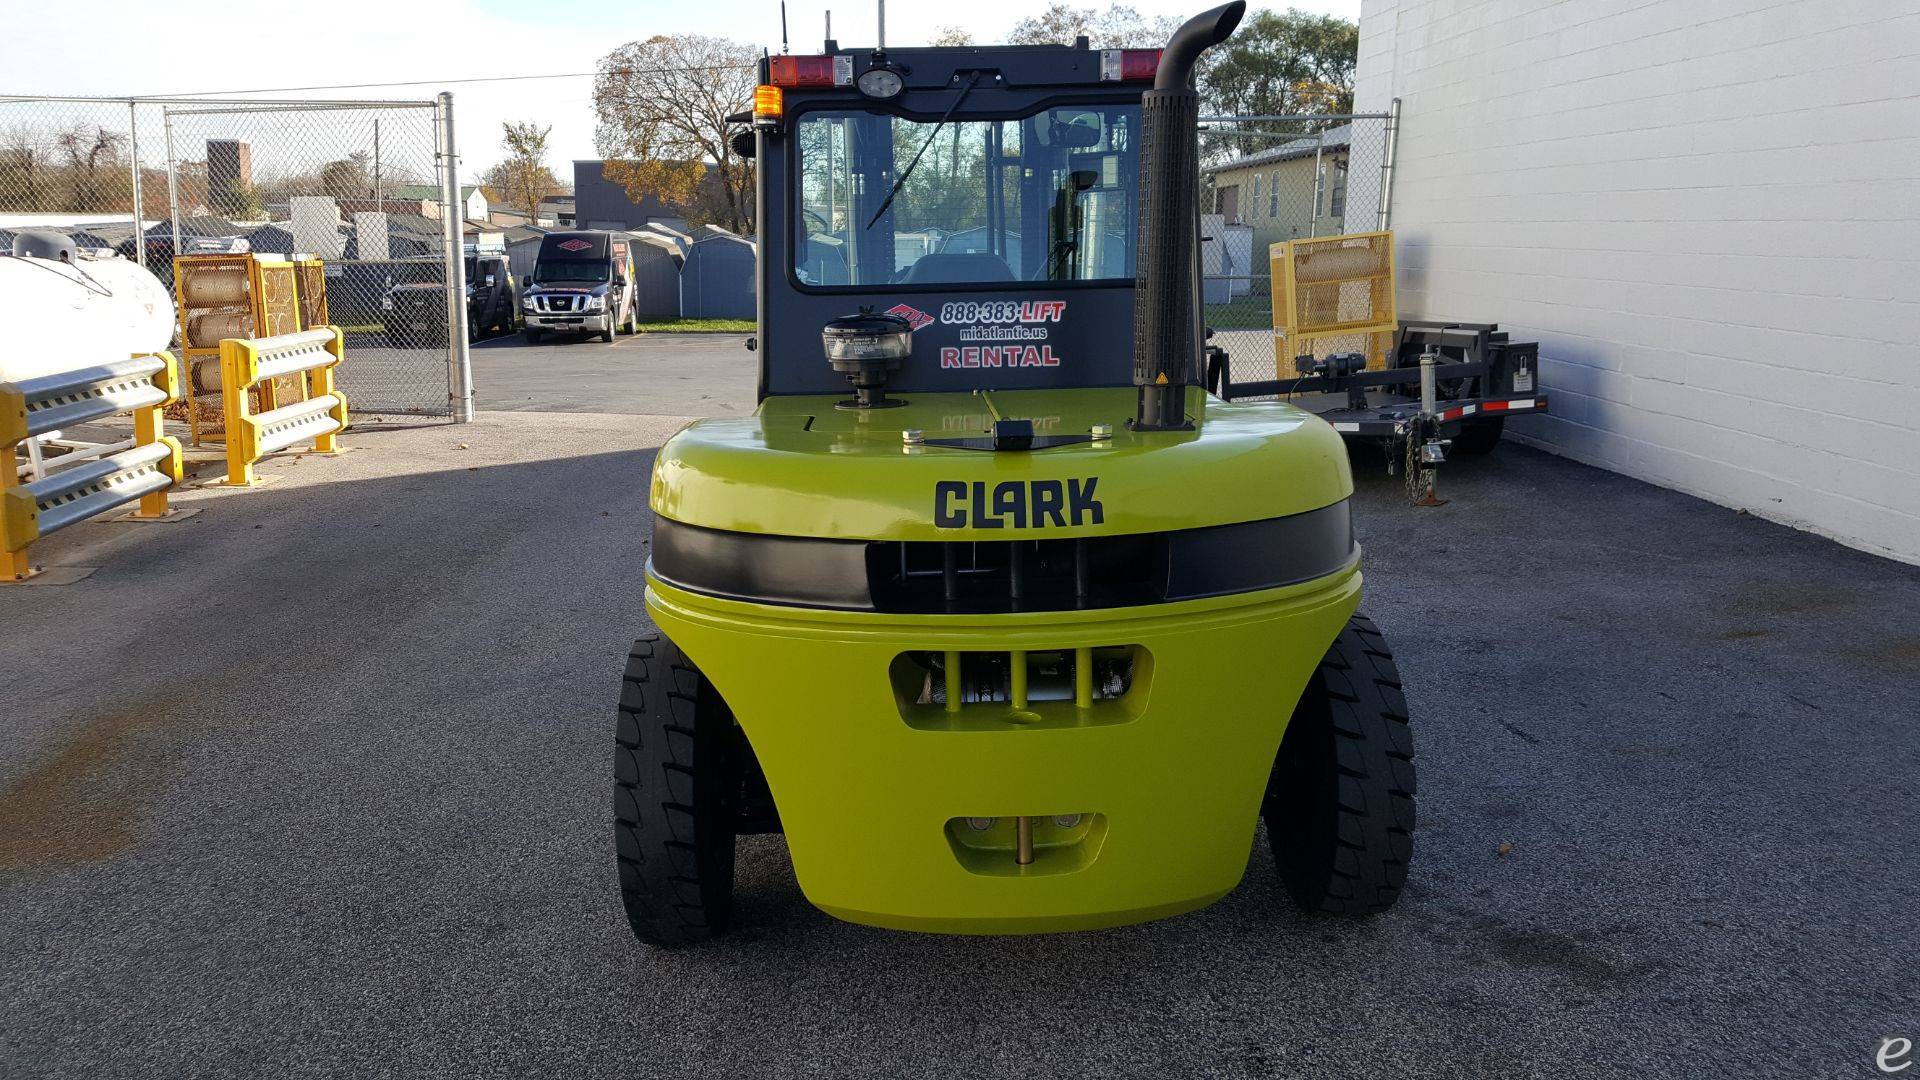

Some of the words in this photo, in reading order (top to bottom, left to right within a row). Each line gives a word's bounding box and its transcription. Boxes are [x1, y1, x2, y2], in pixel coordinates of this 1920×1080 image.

[960, 325, 1048, 341] midatlantic.us
[941, 345, 1061, 368] RENTAL
[934, 477, 1105, 529] CLARK
